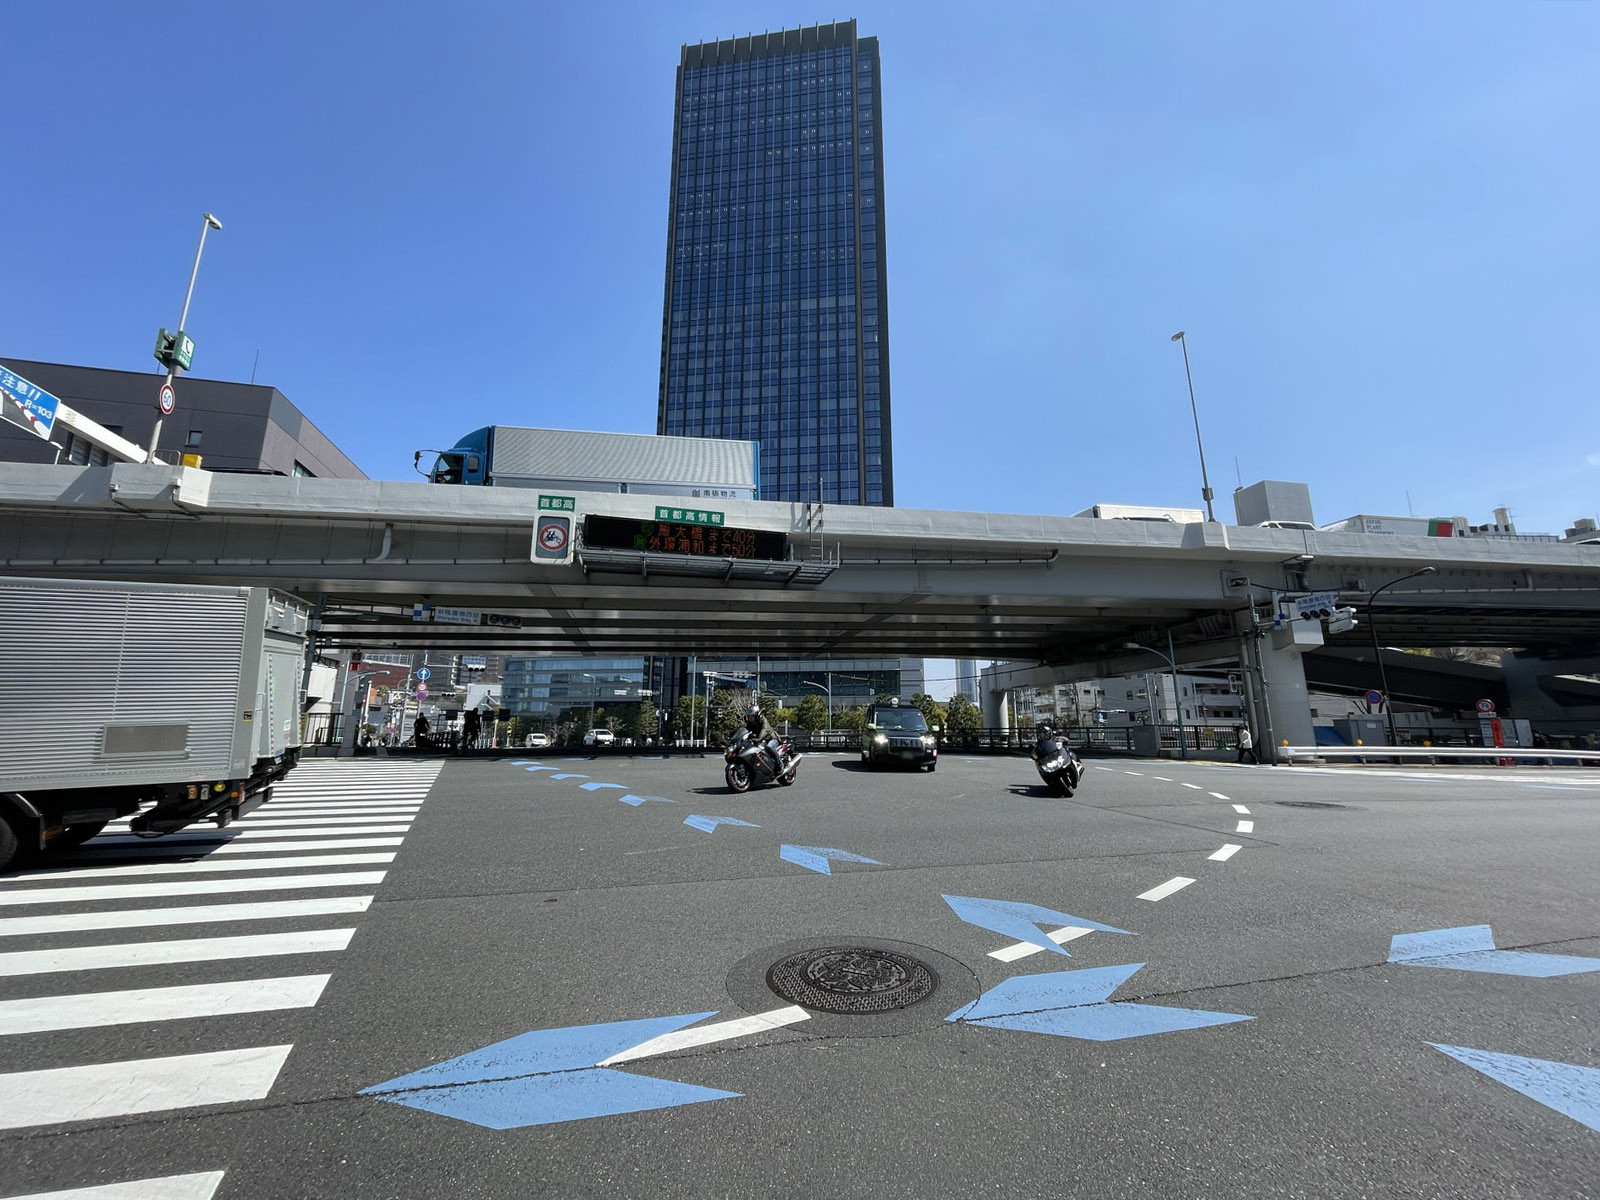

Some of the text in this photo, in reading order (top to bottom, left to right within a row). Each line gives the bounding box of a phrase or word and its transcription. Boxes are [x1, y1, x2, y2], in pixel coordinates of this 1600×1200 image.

[0, 370, 42, 401] 注意!!
[24, 399, 53, 419] R=103
[540, 497, 574, 509] 首都高
[659, 508, 721, 523] 首都高情報
